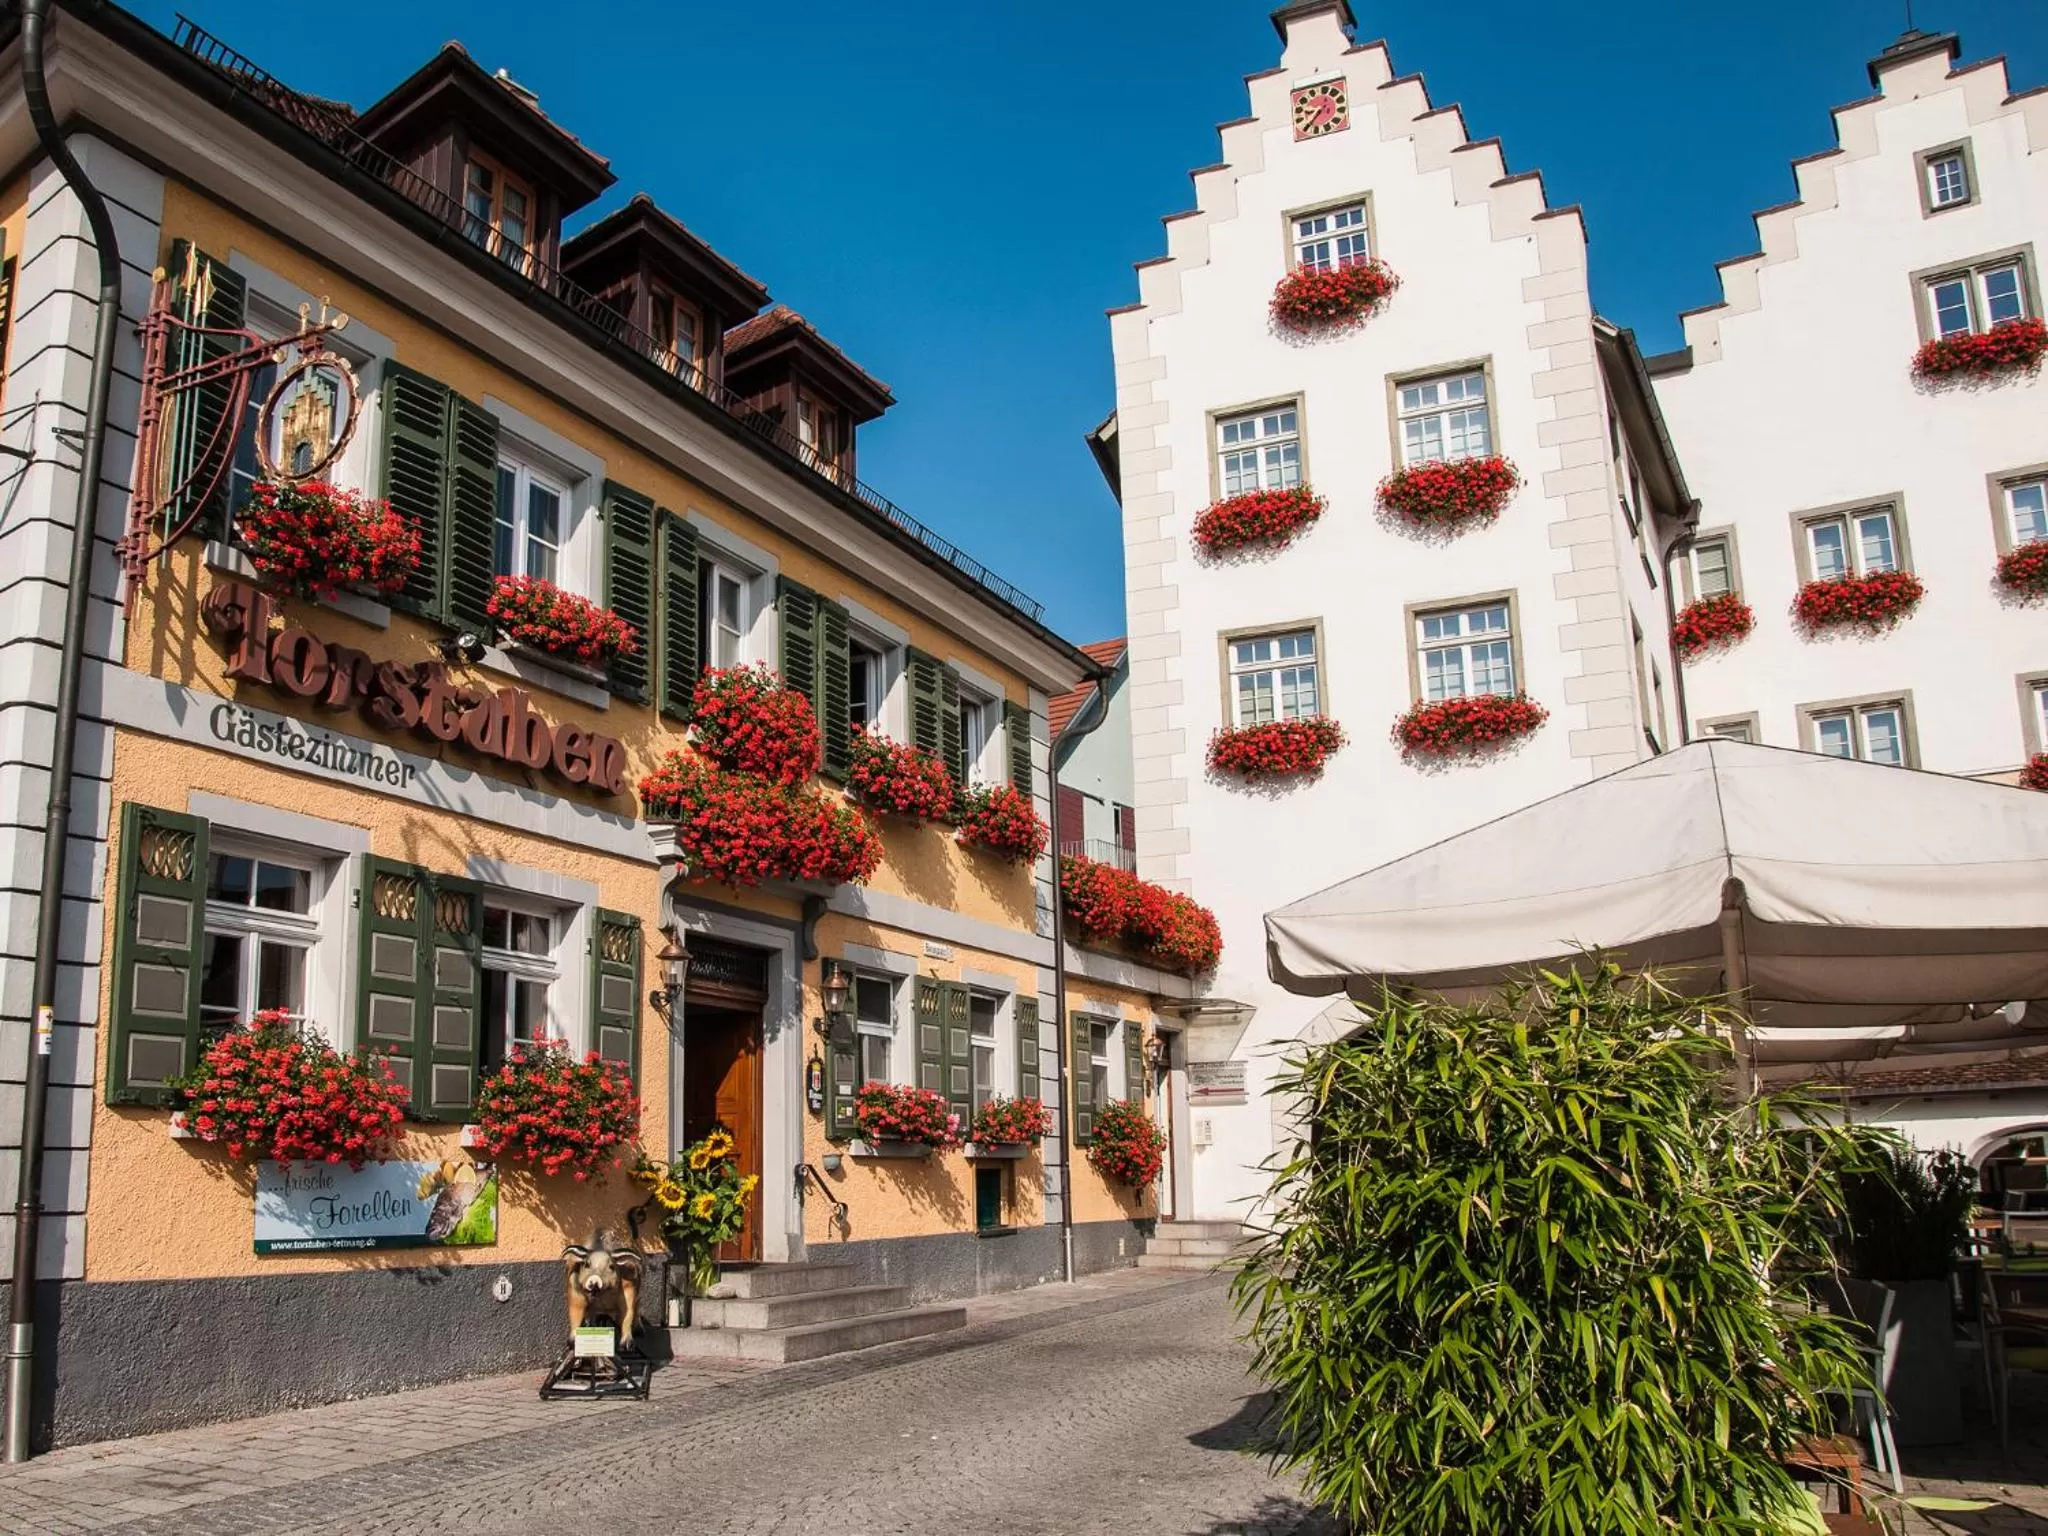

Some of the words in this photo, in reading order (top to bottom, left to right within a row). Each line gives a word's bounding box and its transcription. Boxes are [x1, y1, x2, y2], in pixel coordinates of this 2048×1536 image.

[201, 583, 627, 795] Torstuben
[210, 703, 416, 788] Gästezimmer
[309, 1190, 411, 1229] Forellen
